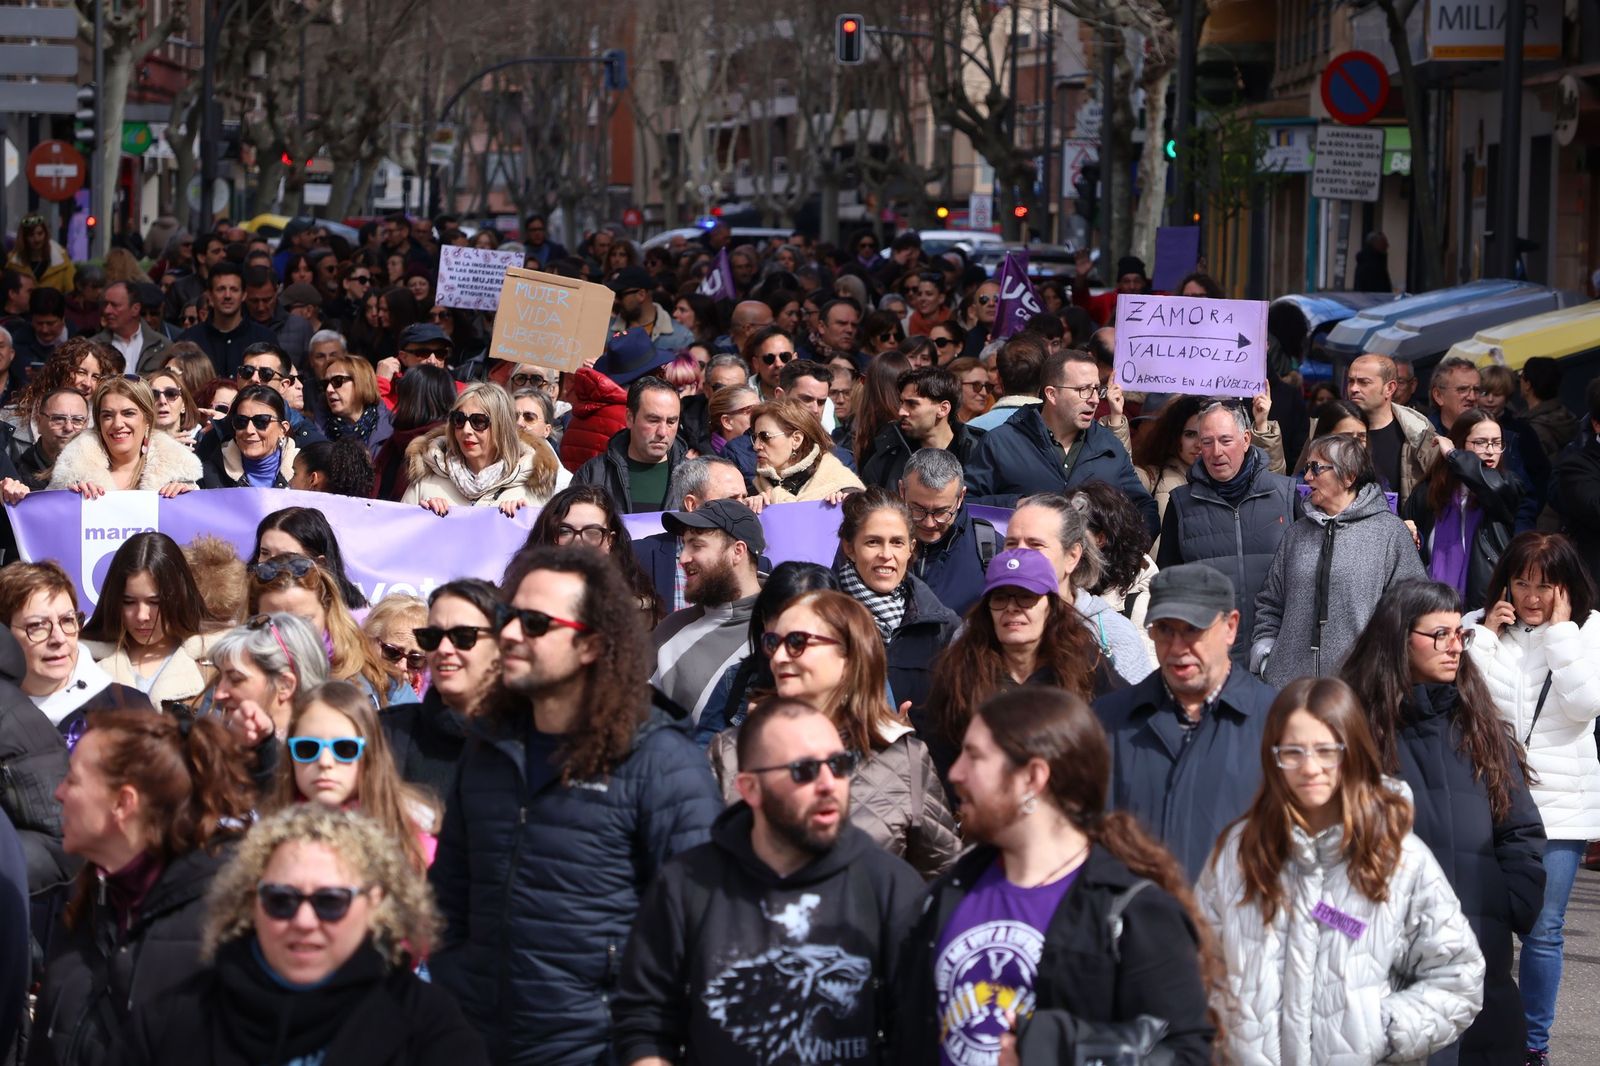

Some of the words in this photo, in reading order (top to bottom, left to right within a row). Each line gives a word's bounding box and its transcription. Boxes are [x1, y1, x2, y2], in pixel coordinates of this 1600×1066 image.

[1327, 131, 1373, 140] LABORABLES
[1315, 177, 1348, 185] EXCEPTO
[1351, 179, 1376, 187] CARGA
[460, 290, 495, 298] ETIQUETAS
[515, 282, 573, 309] MUJER
[516, 303, 563, 329] VIDA
[1125, 301, 1233, 327] ZAMORA
[502, 320, 582, 354] LIBERTAD
[1129, 341, 1249, 363] VALLADOLID
[1136, 374, 1177, 384] ABORTOS
[1181, 376, 1195, 387] EN
[1200, 378, 1212, 388] LA
[1315, 901, 1362, 937] FEMINISTA
